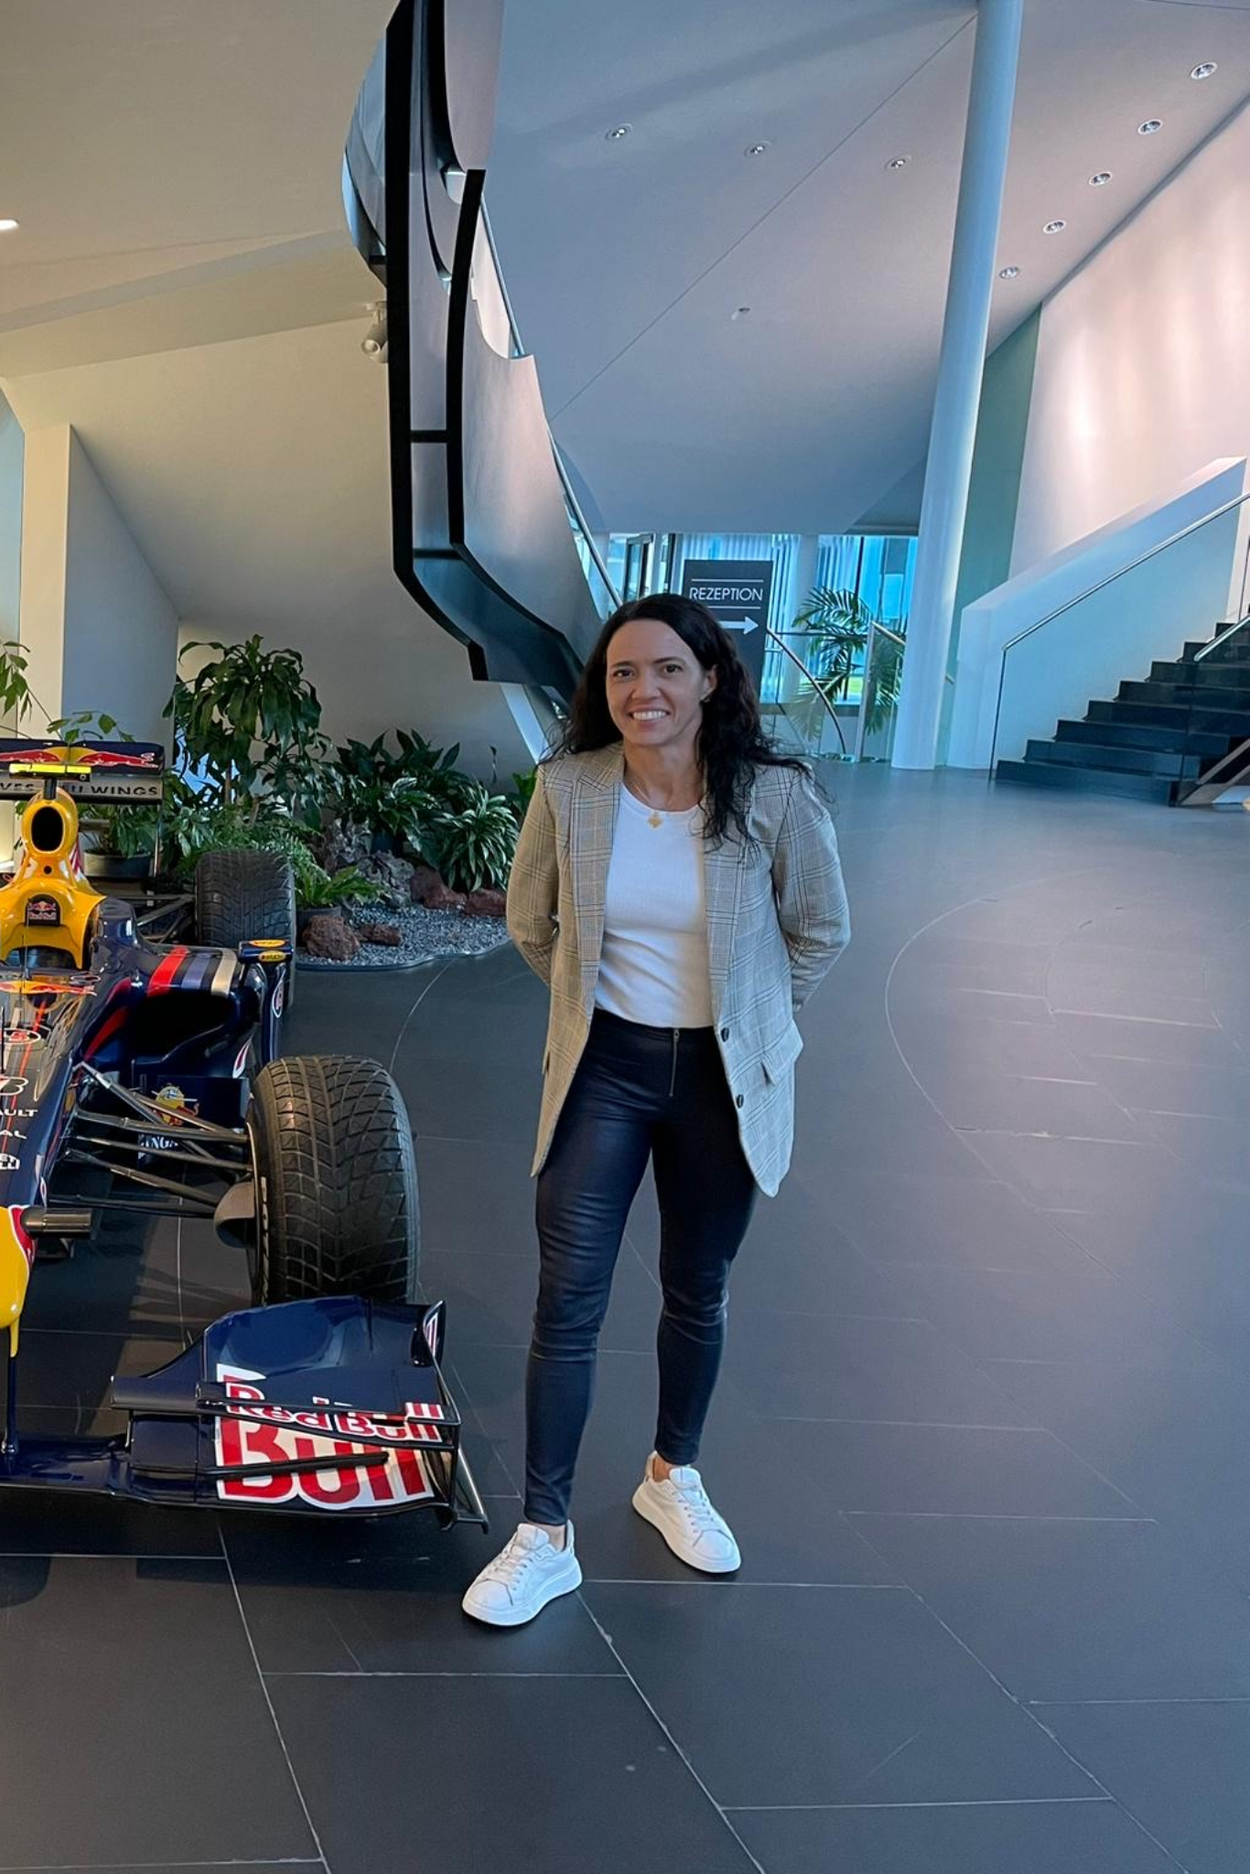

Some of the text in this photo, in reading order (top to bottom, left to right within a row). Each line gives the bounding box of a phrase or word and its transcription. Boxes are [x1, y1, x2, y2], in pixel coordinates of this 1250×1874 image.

[689, 587, 763, 601] REZEPTION
[90, 786, 158, 796] WINGS
[225, 1382, 444, 1443] Red Bull
[214, 1414, 434, 1510] Bull
